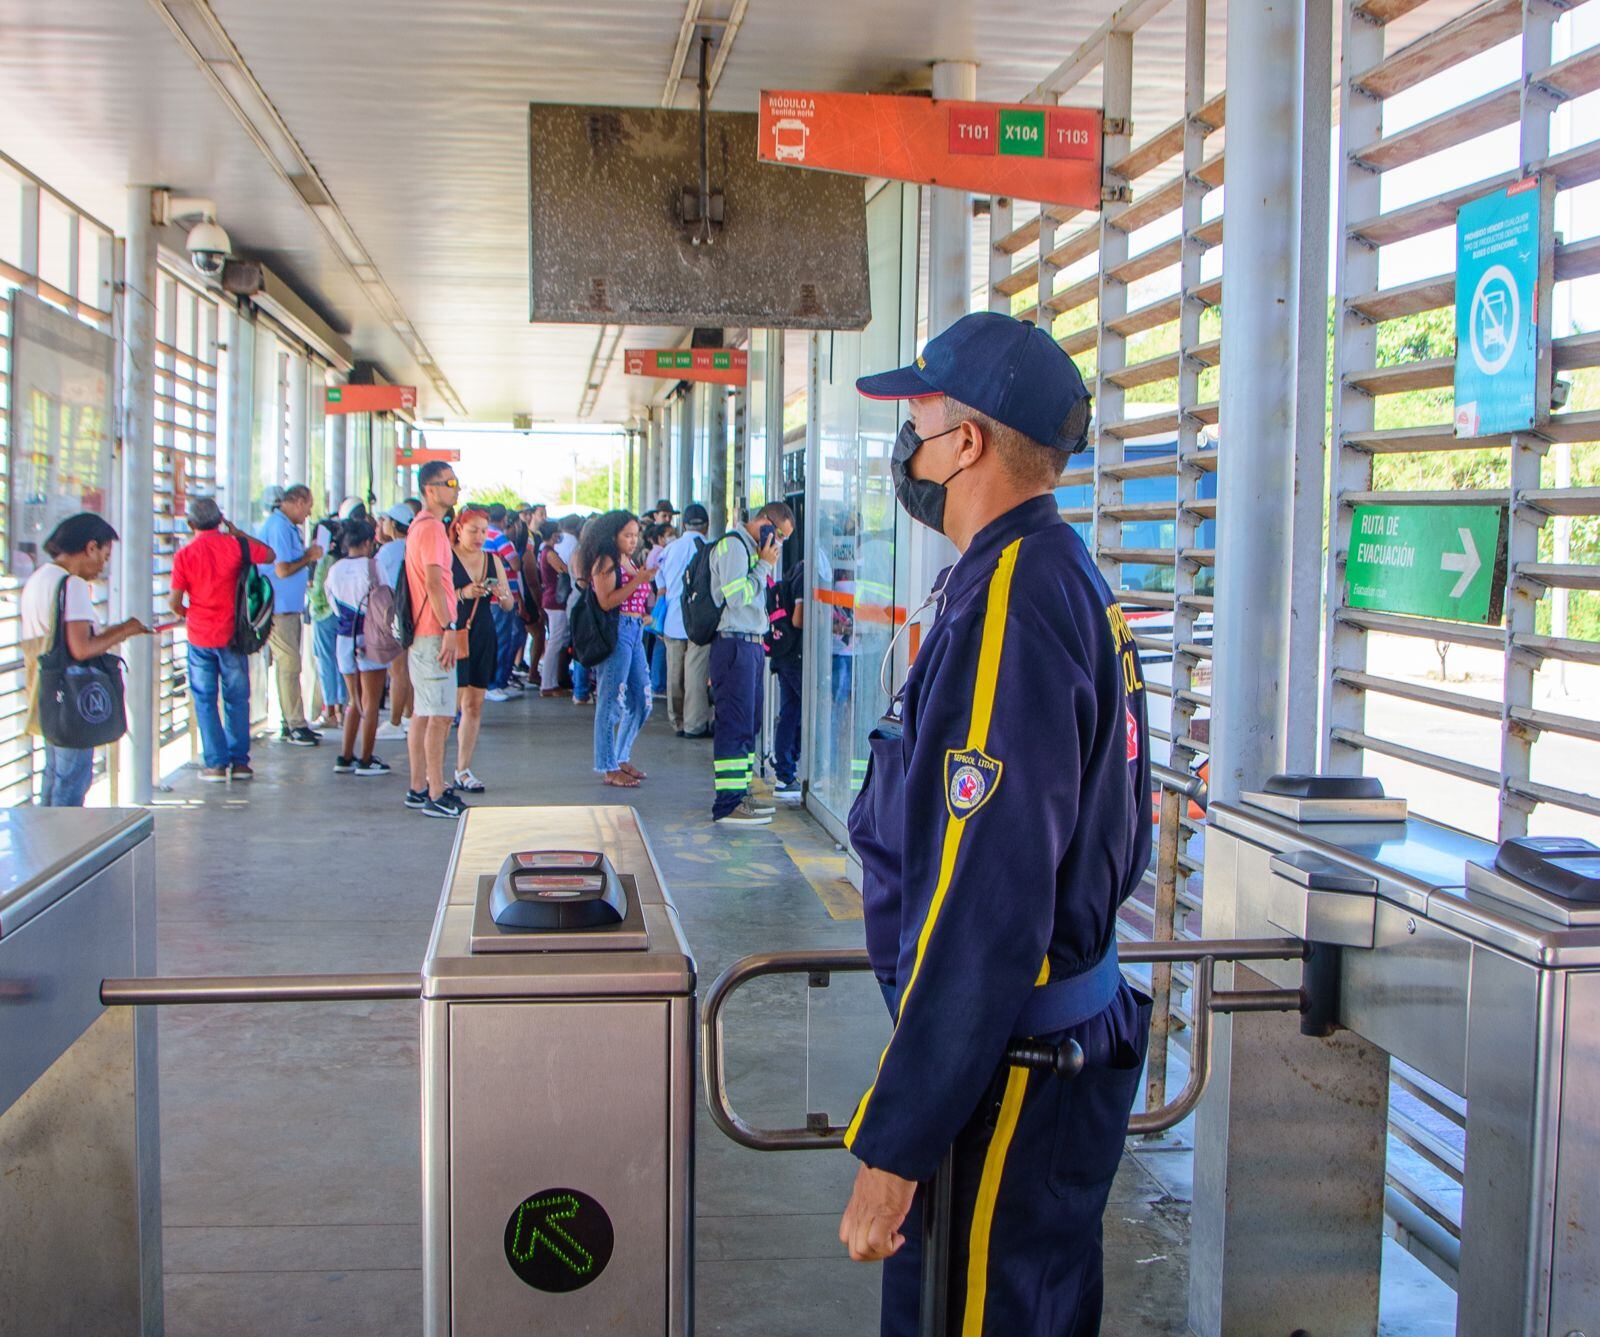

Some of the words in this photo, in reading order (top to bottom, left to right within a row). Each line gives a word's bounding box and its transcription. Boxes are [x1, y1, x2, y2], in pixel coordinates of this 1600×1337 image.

[769, 96, 807, 109] MÓDULO
[809, 98, 816, 110] A
[958, 124, 989, 140] T101
[1006, 125, 1039, 142] X104
[1056, 128, 1089, 145] T103
[1361, 514, 1384, 535] RUTA
[1386, 515, 1400, 536] DE
[1357, 540, 1416, 568] EVACUACIÓN
